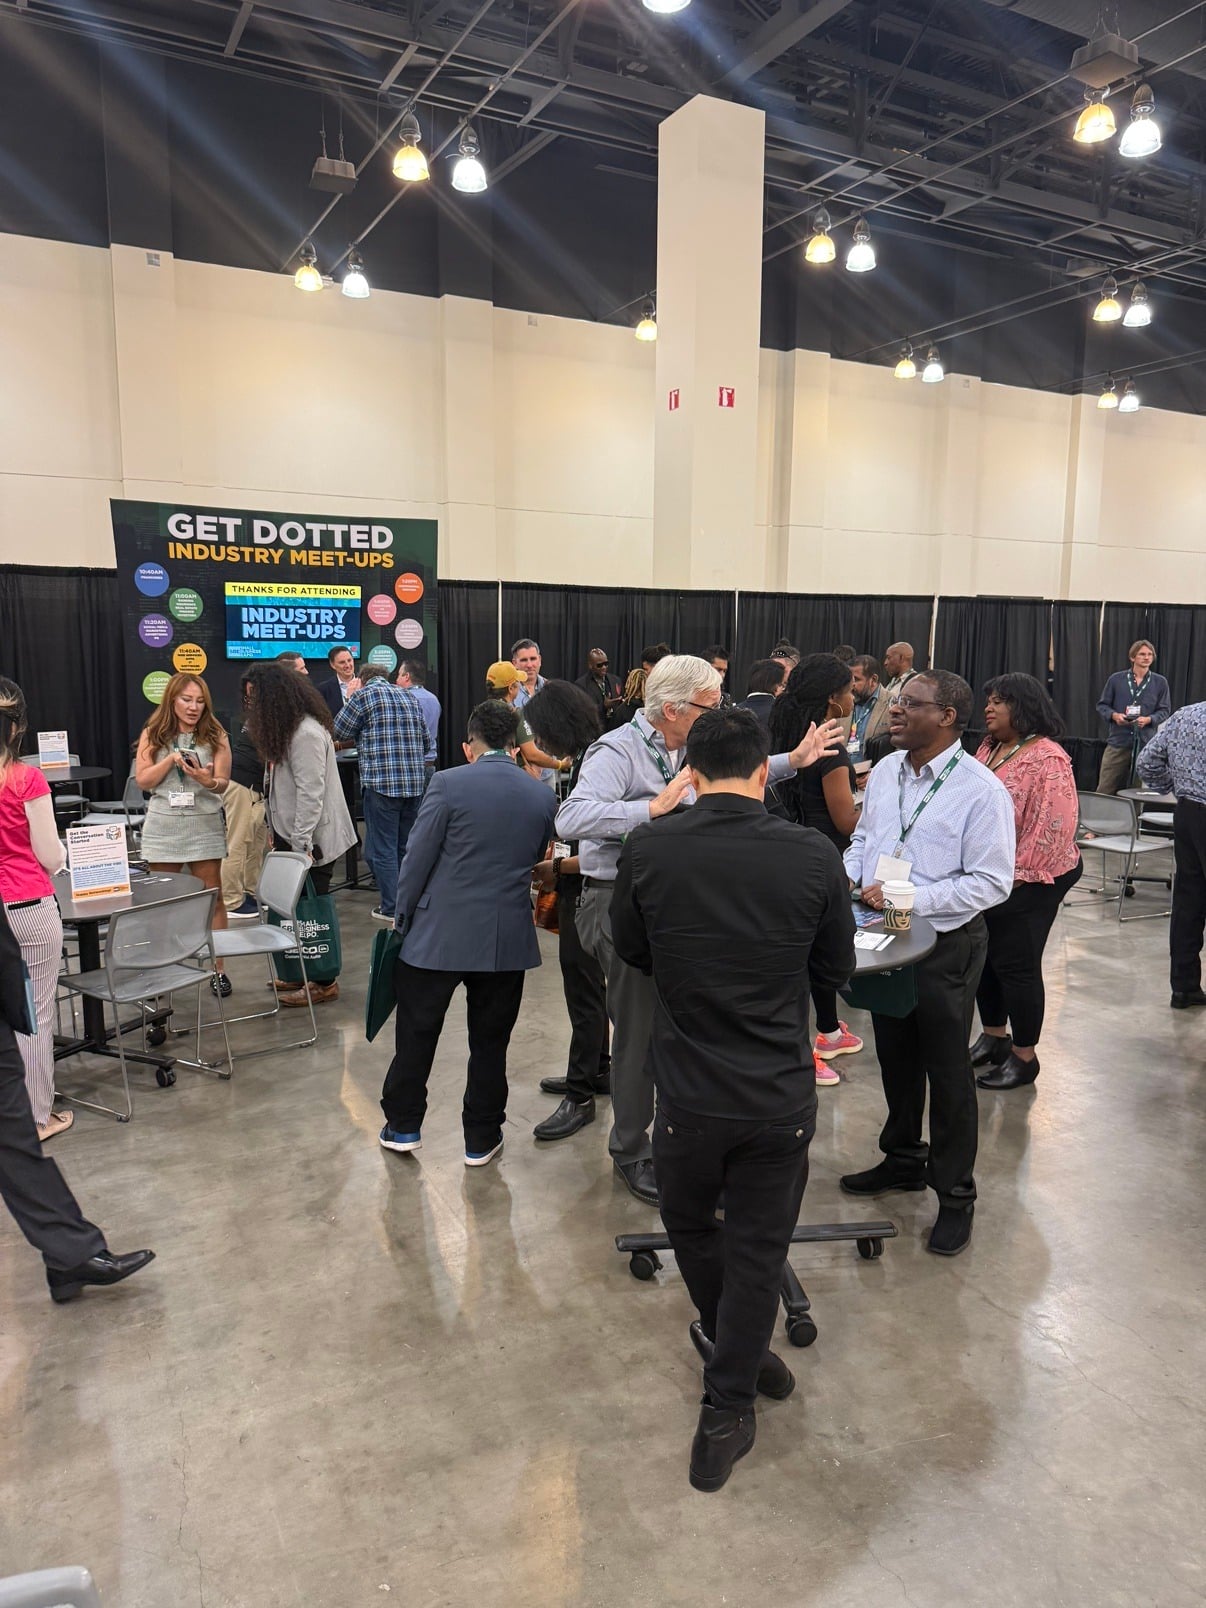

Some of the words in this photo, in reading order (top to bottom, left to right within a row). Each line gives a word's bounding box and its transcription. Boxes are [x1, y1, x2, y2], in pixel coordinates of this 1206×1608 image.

[167, 513, 242, 542] GET
[253, 519, 394, 549] DOTTED
[168, 542, 284, 565] INDUSTRY
[290, 550, 395, 568] MEET-UPS
[232, 585, 274, 594] THANKS
[277, 586, 297, 594] FOR
[300, 587, 356, 596] ATTENDING
[241, 607, 347, 624] INDUSTRY
[242, 623, 346, 639] MEET-UPS
